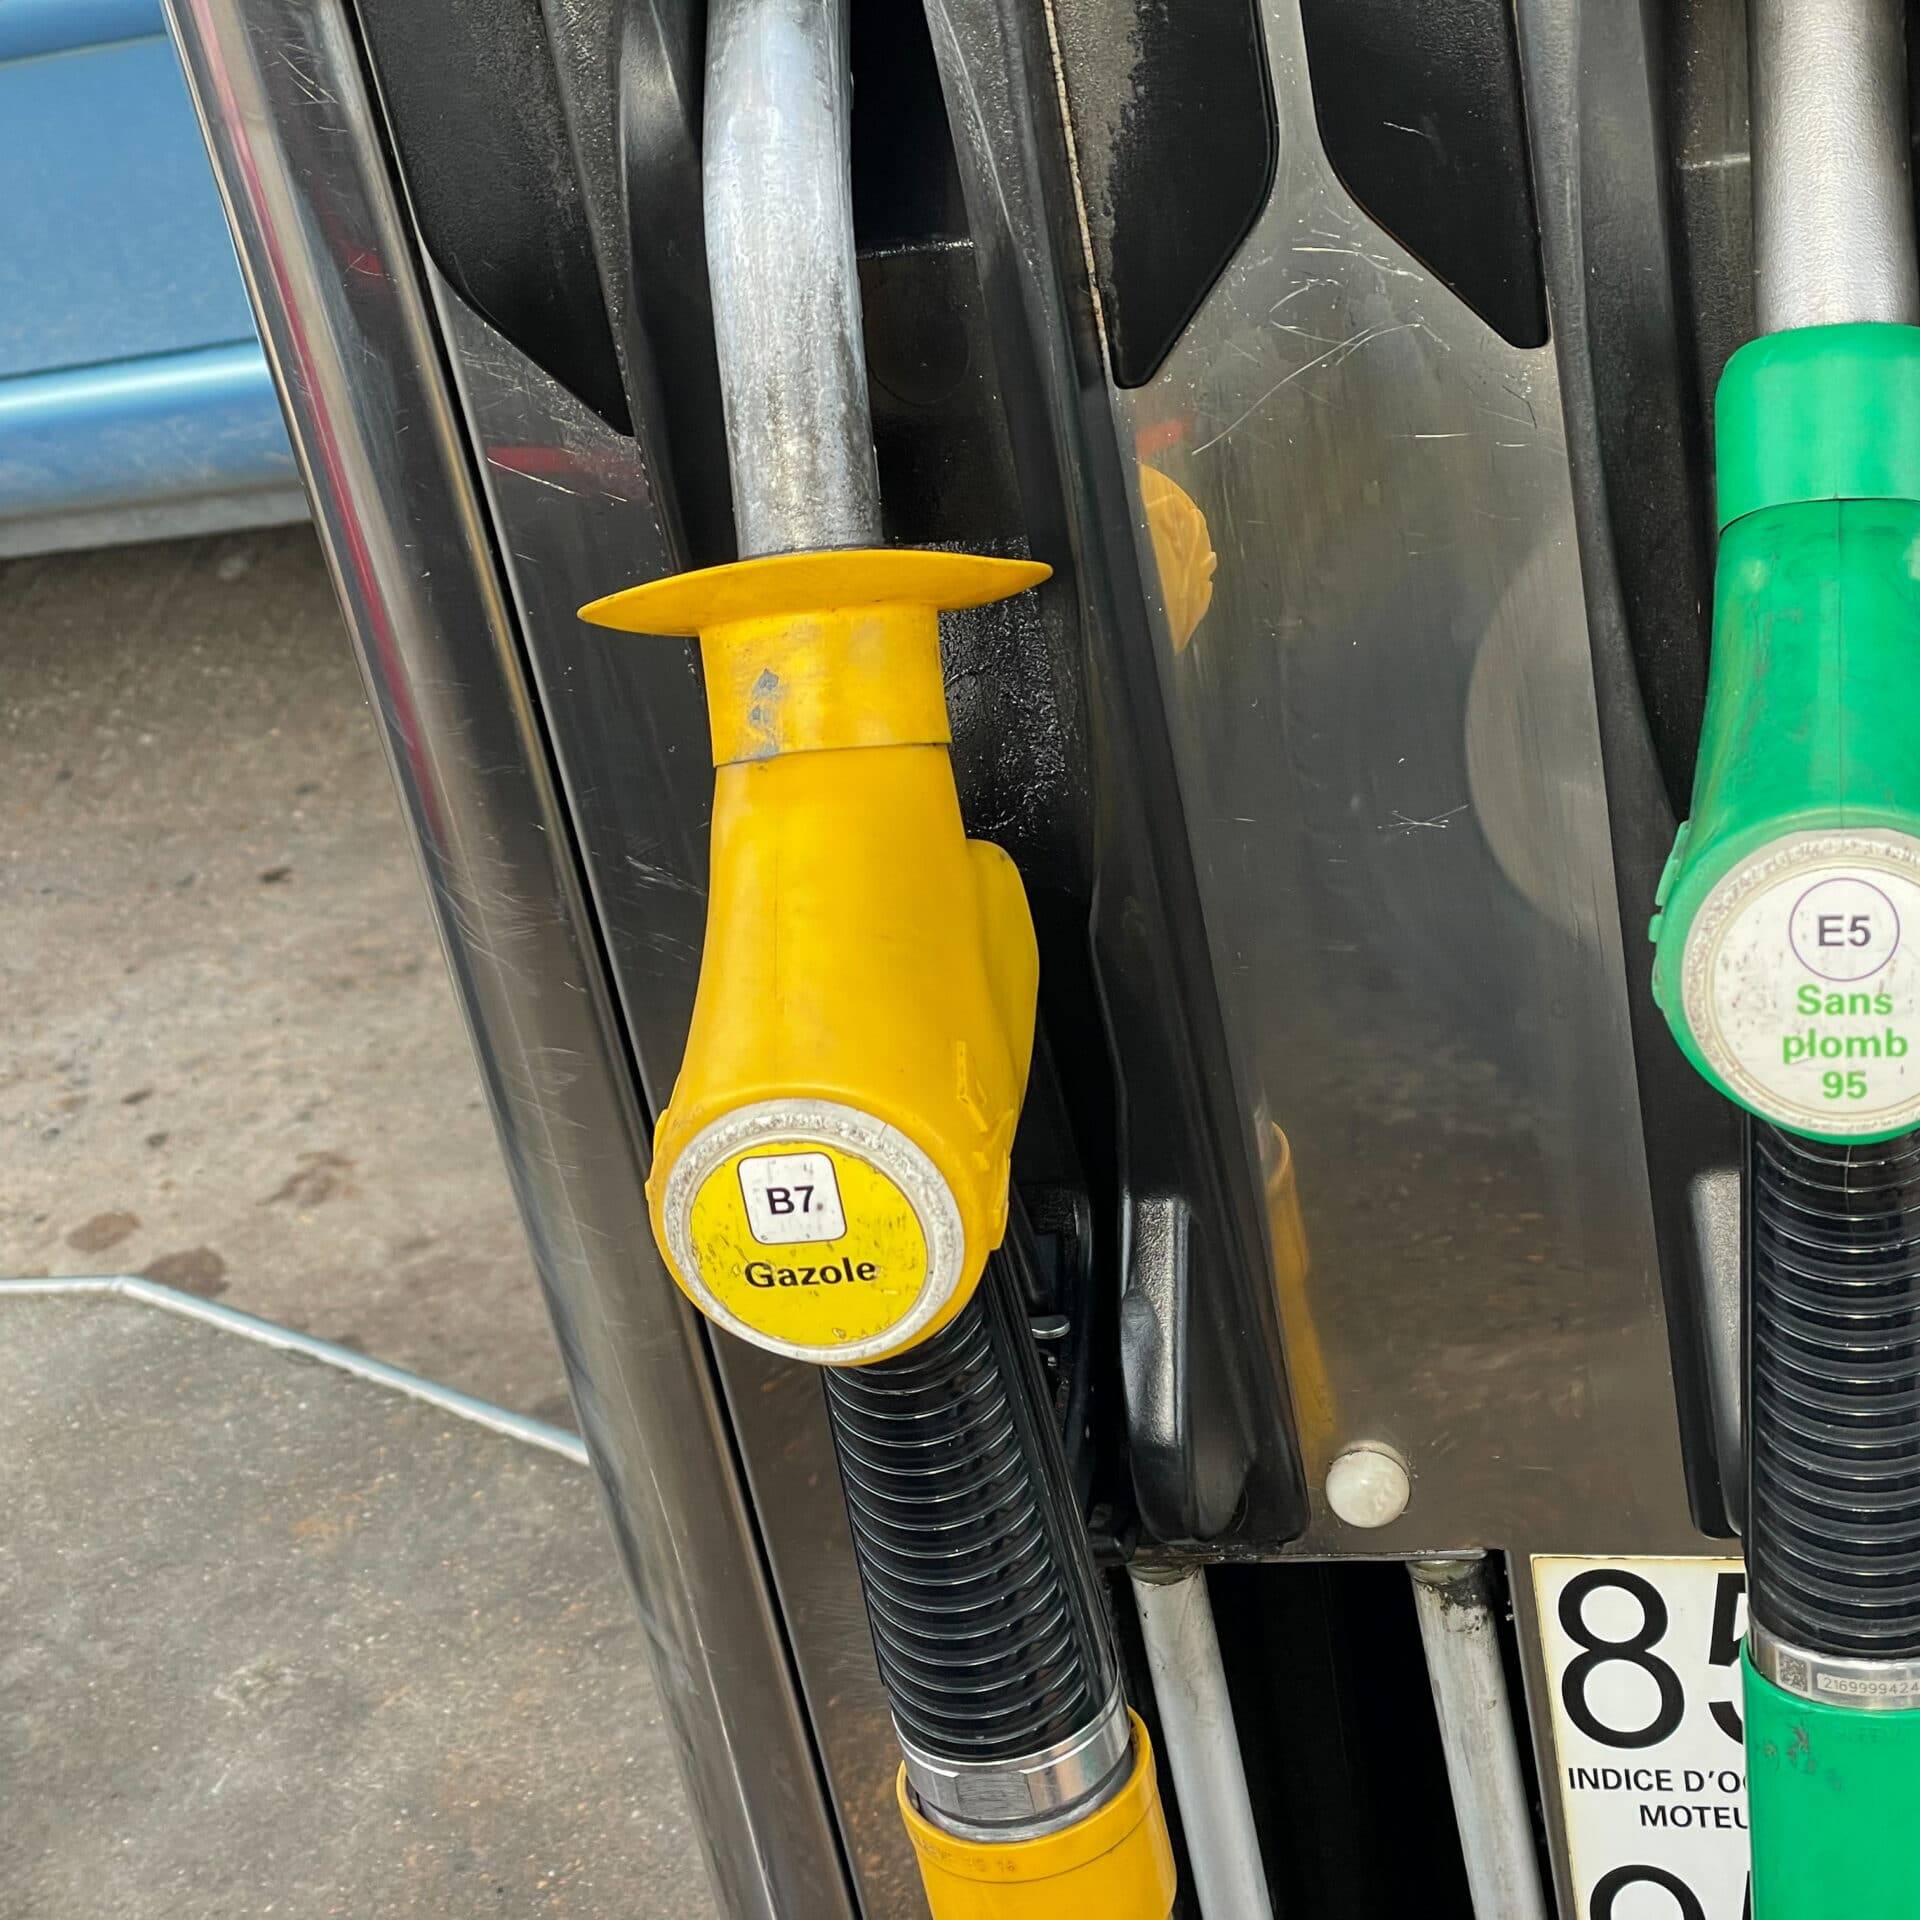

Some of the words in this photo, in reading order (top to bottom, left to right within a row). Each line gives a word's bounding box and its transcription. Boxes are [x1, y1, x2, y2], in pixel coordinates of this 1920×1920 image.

[1818, 915, 1872, 947] E5
[1797, 984, 1893, 1016] Sans
[1783, 1028, 1908, 1064] plomb
[1822, 1070, 1868, 1100] 95
[765, 1185, 815, 1215] B7
[744, 1257, 877, 1287] Gazole
[1568, 1767, 1674, 1792] INDICE
[1683, 1770, 1747, 1793] D'O
